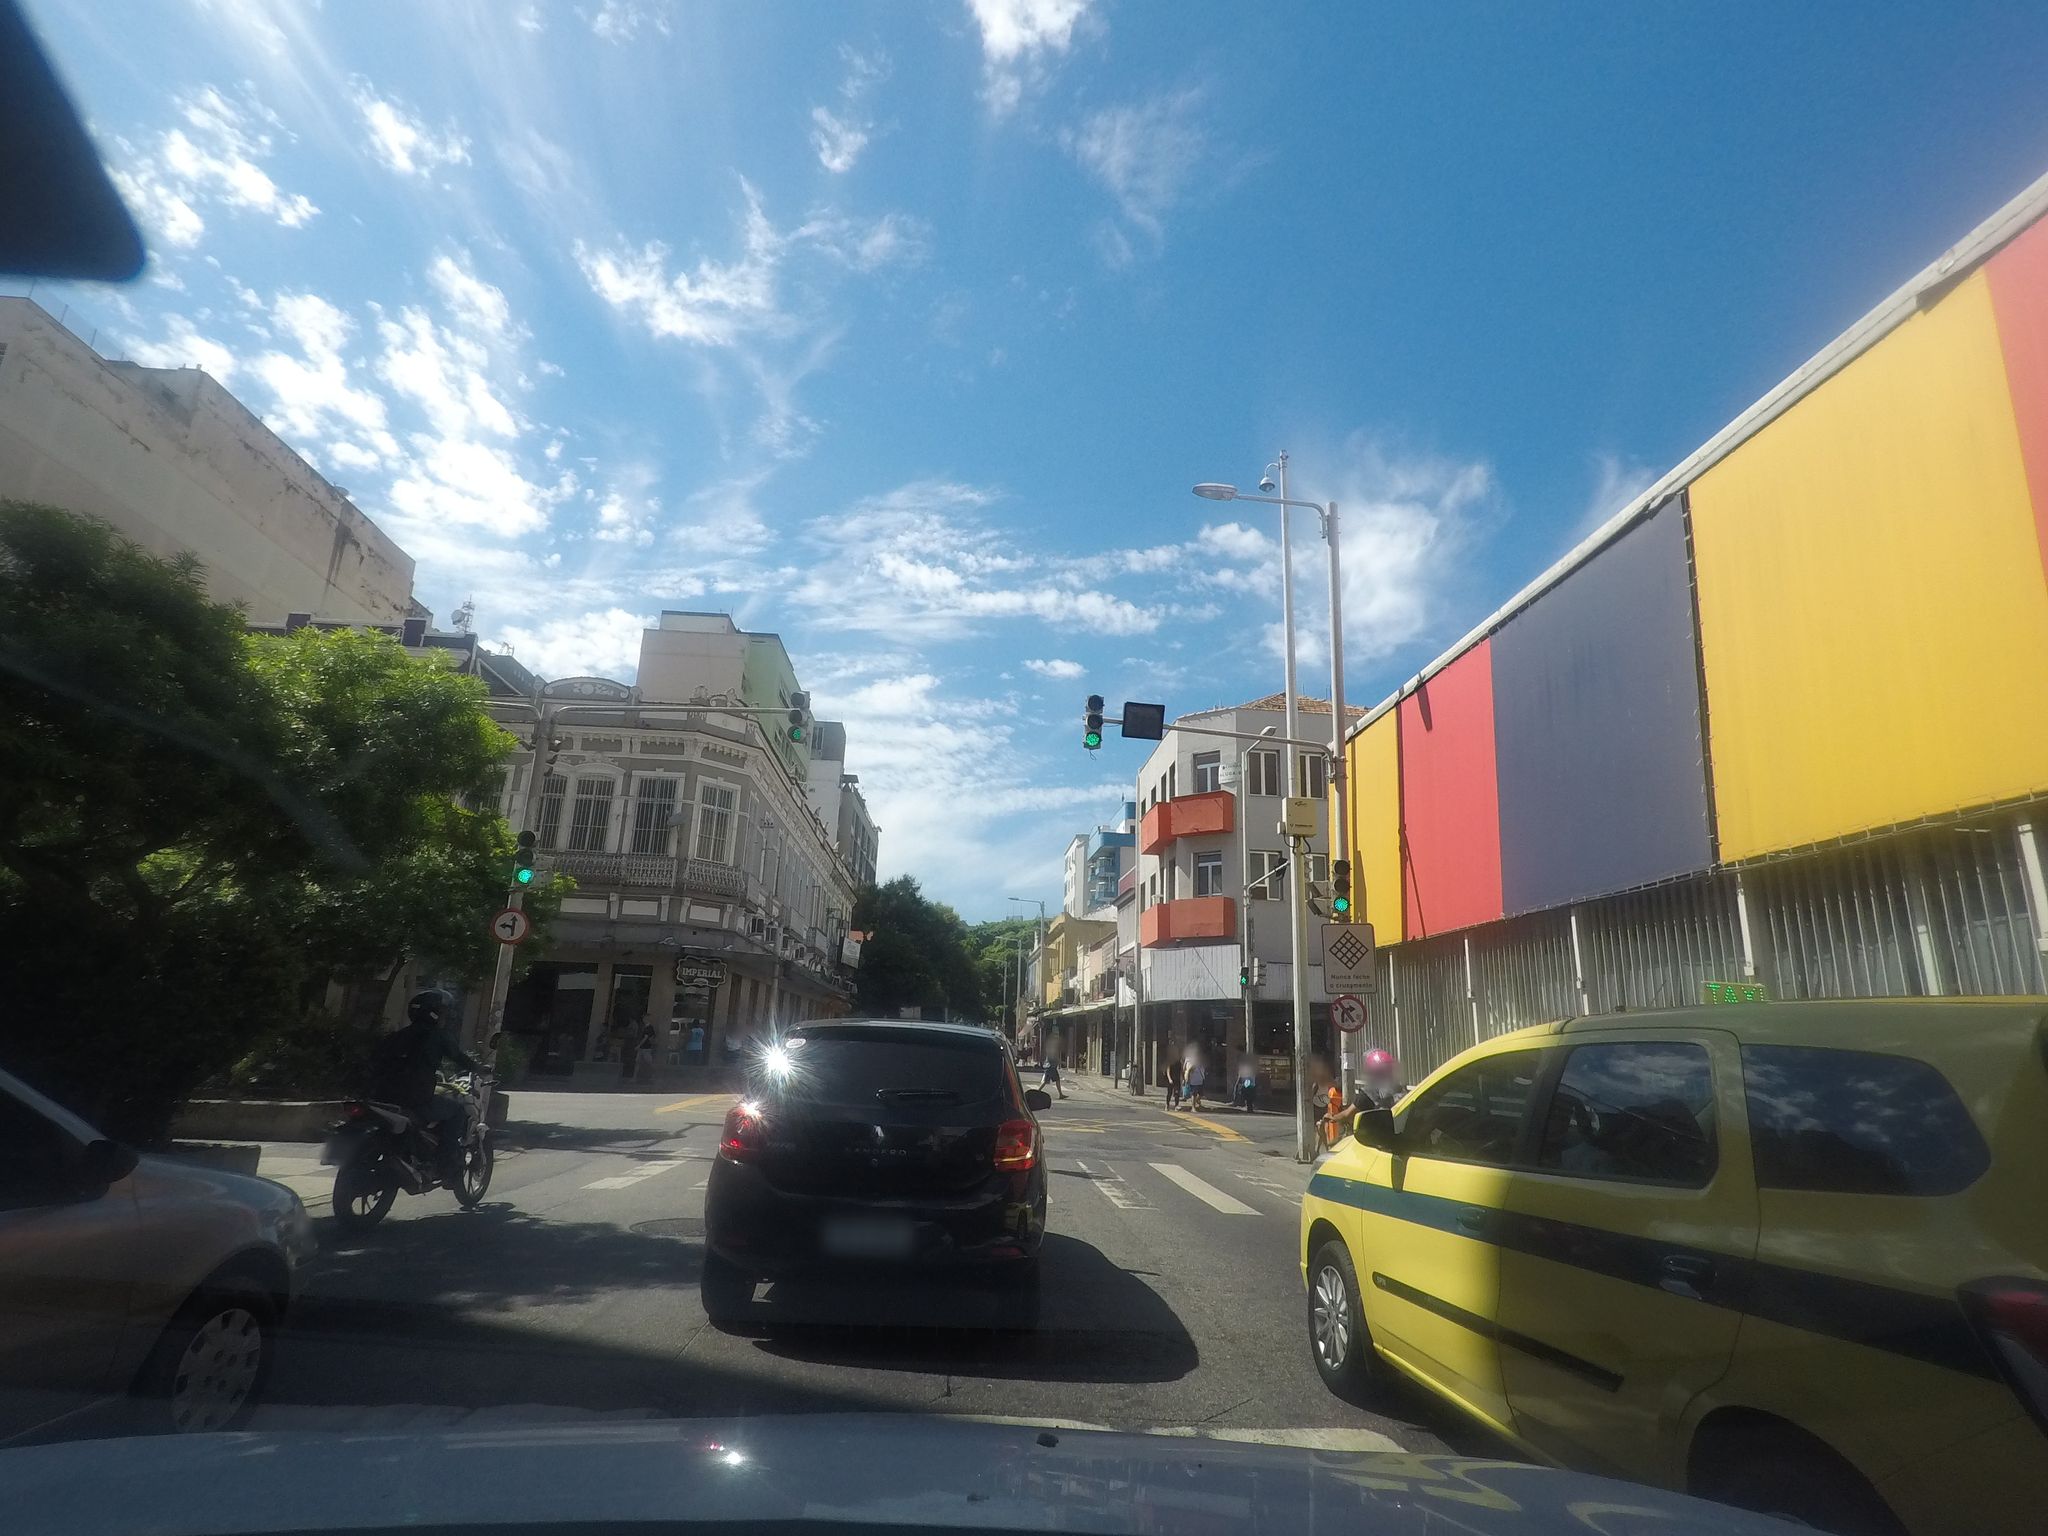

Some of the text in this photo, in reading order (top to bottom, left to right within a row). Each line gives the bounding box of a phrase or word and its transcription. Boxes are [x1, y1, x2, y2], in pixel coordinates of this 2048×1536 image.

[682, 967, 722, 979] IMPERIAL
[1336, 982, 1373, 990] cruzamento
[1706, 983, 1765, 1004] TAXI
